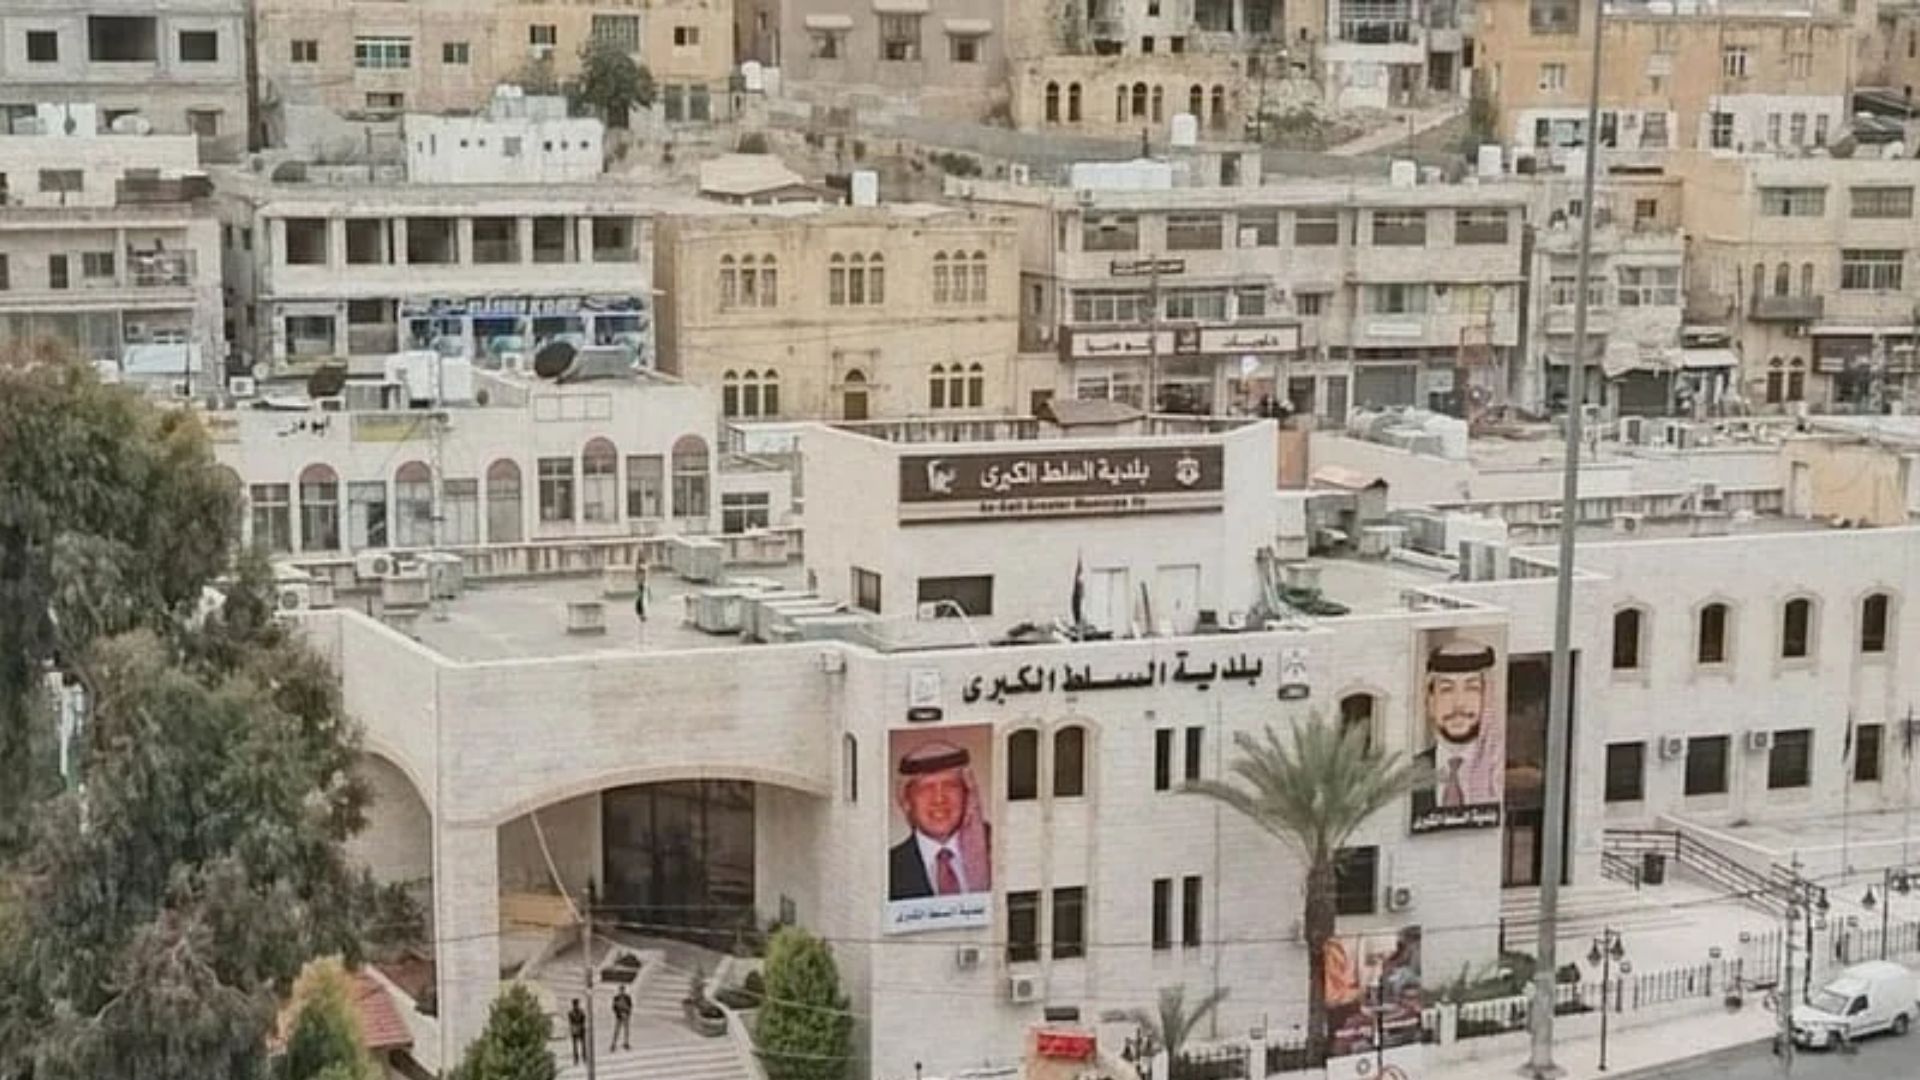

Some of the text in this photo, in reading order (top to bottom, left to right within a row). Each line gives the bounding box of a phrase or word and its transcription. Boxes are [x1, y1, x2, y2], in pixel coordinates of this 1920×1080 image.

[980, 457, 1150, 492] بلدية السلط الكبرى
[962, 664, 1056, 704] الكبرى
[1062, 660, 1166, 693] السلط
[1171, 651, 1263, 693] بلدية
